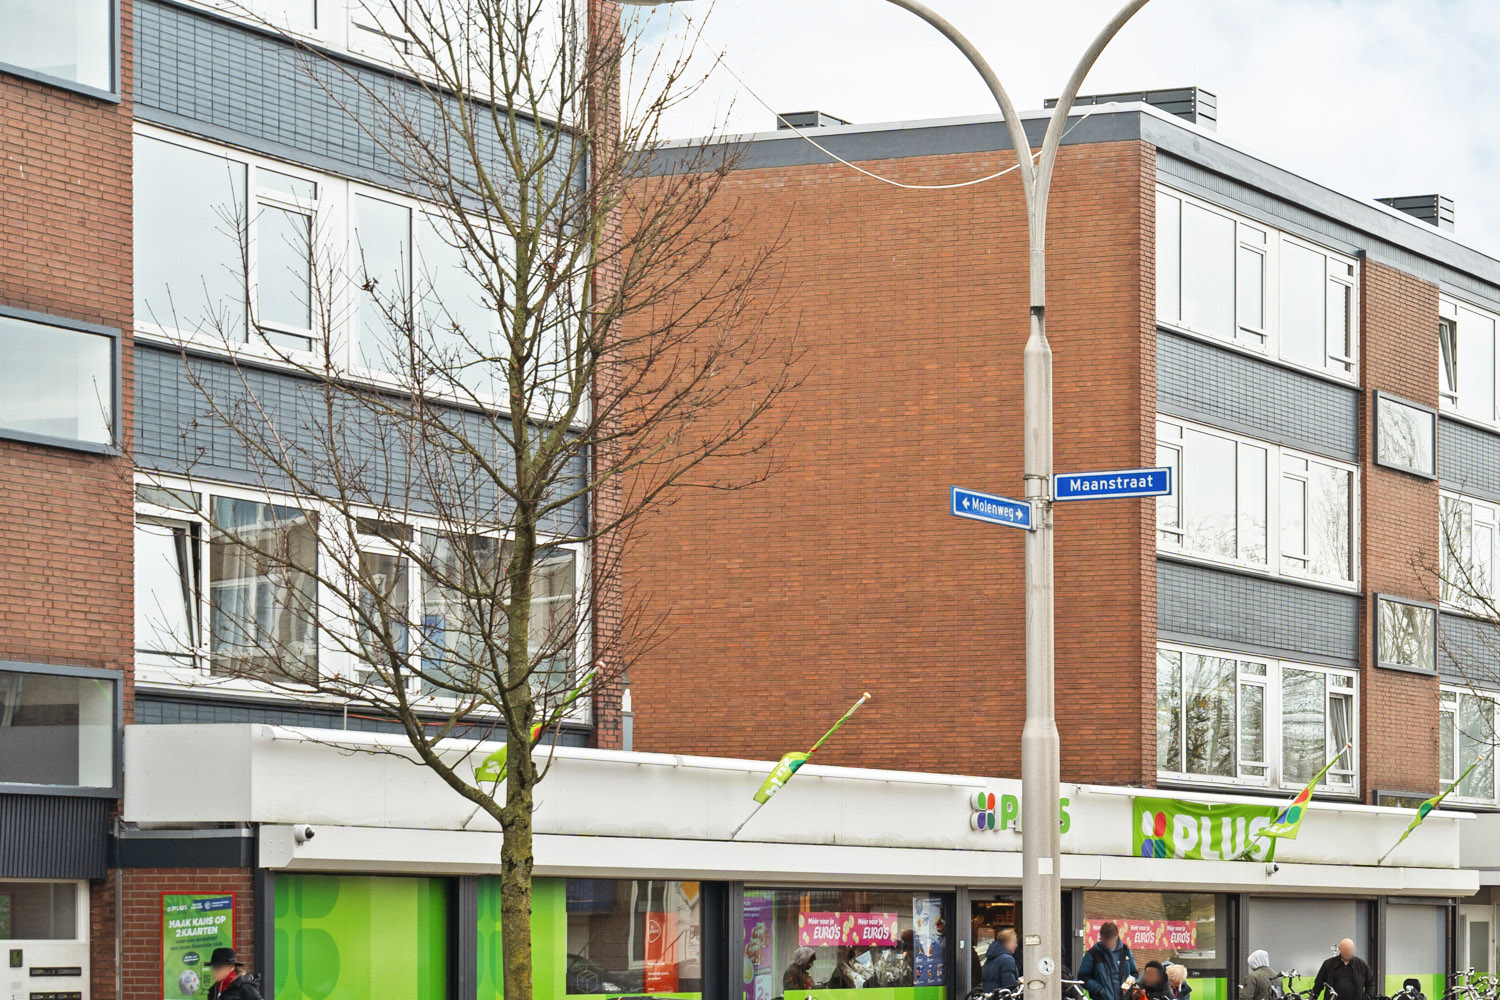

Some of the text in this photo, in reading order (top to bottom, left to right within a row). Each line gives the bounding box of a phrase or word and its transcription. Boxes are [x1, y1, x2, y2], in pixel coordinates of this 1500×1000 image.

[1070, 474, 1153, 492] Maanstraat
[972, 497, 1014, 521] Molenweg
[1001, 794, 1071, 834] PS
[1172, 814, 1272, 862] PLUS
[169, 915, 226, 929] MAAK KANS OP
[182, 926, 218, 937] KAARTEN
